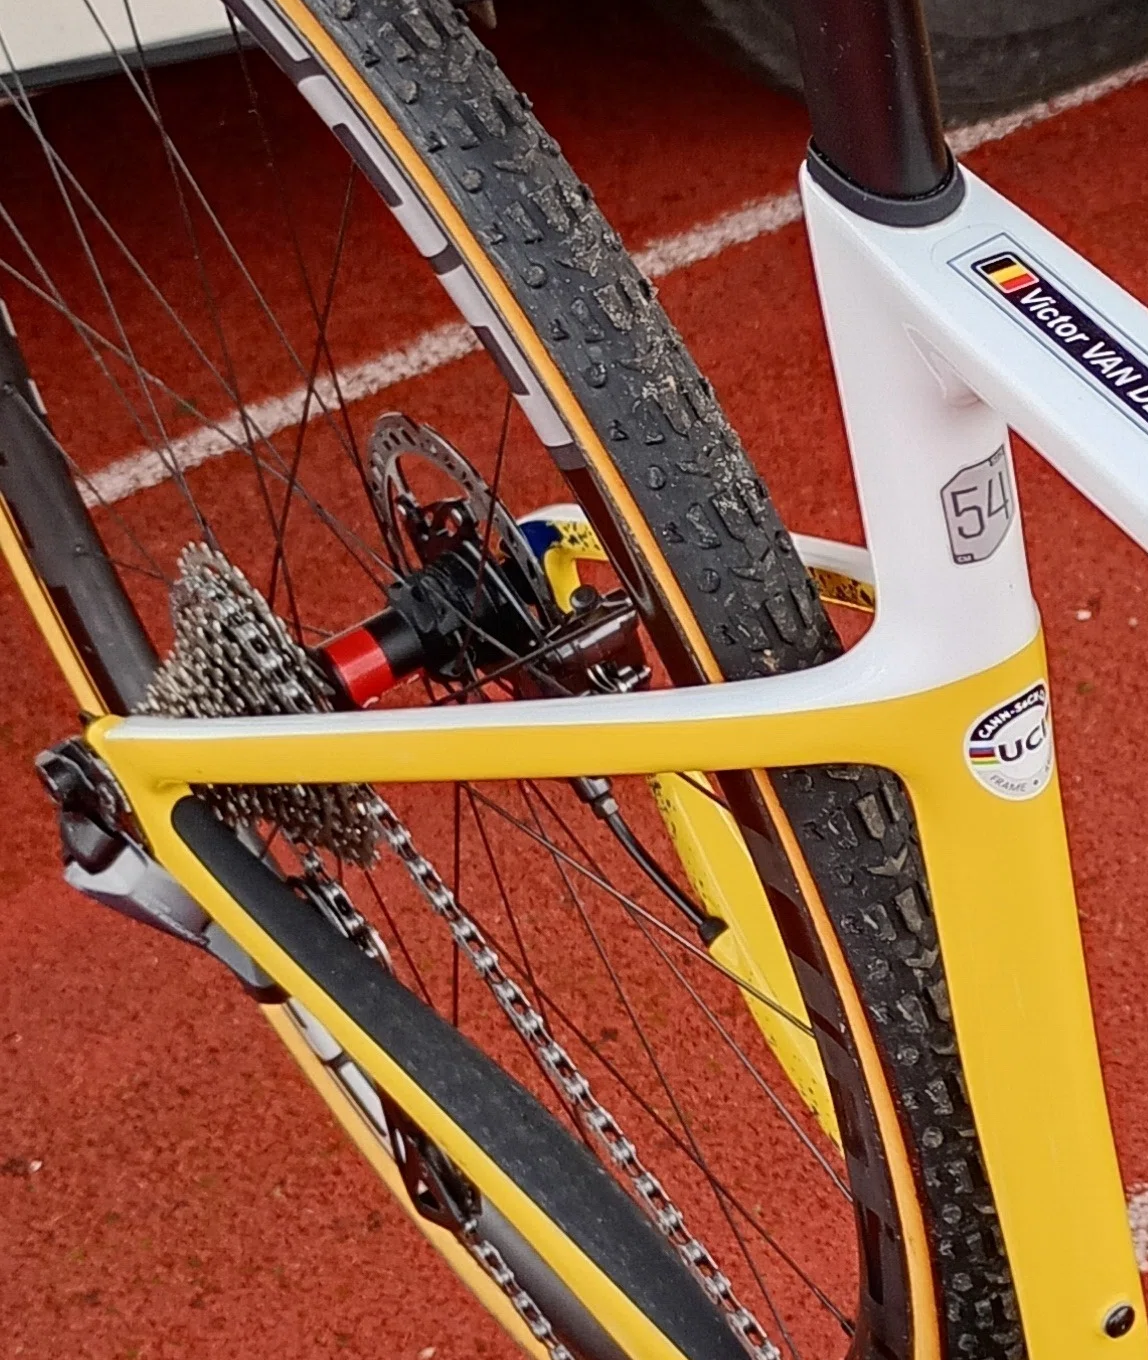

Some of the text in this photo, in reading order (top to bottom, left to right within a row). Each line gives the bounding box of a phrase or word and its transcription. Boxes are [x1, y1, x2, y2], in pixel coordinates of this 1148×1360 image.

[1020, 288, 1089, 343] Victor
[1082, 341, 1142, 387] VAN
[950, 471, 1010, 540] 54
[998, 719, 1047, 762] UCI
[989, 774, 1028, 793] FRAME
